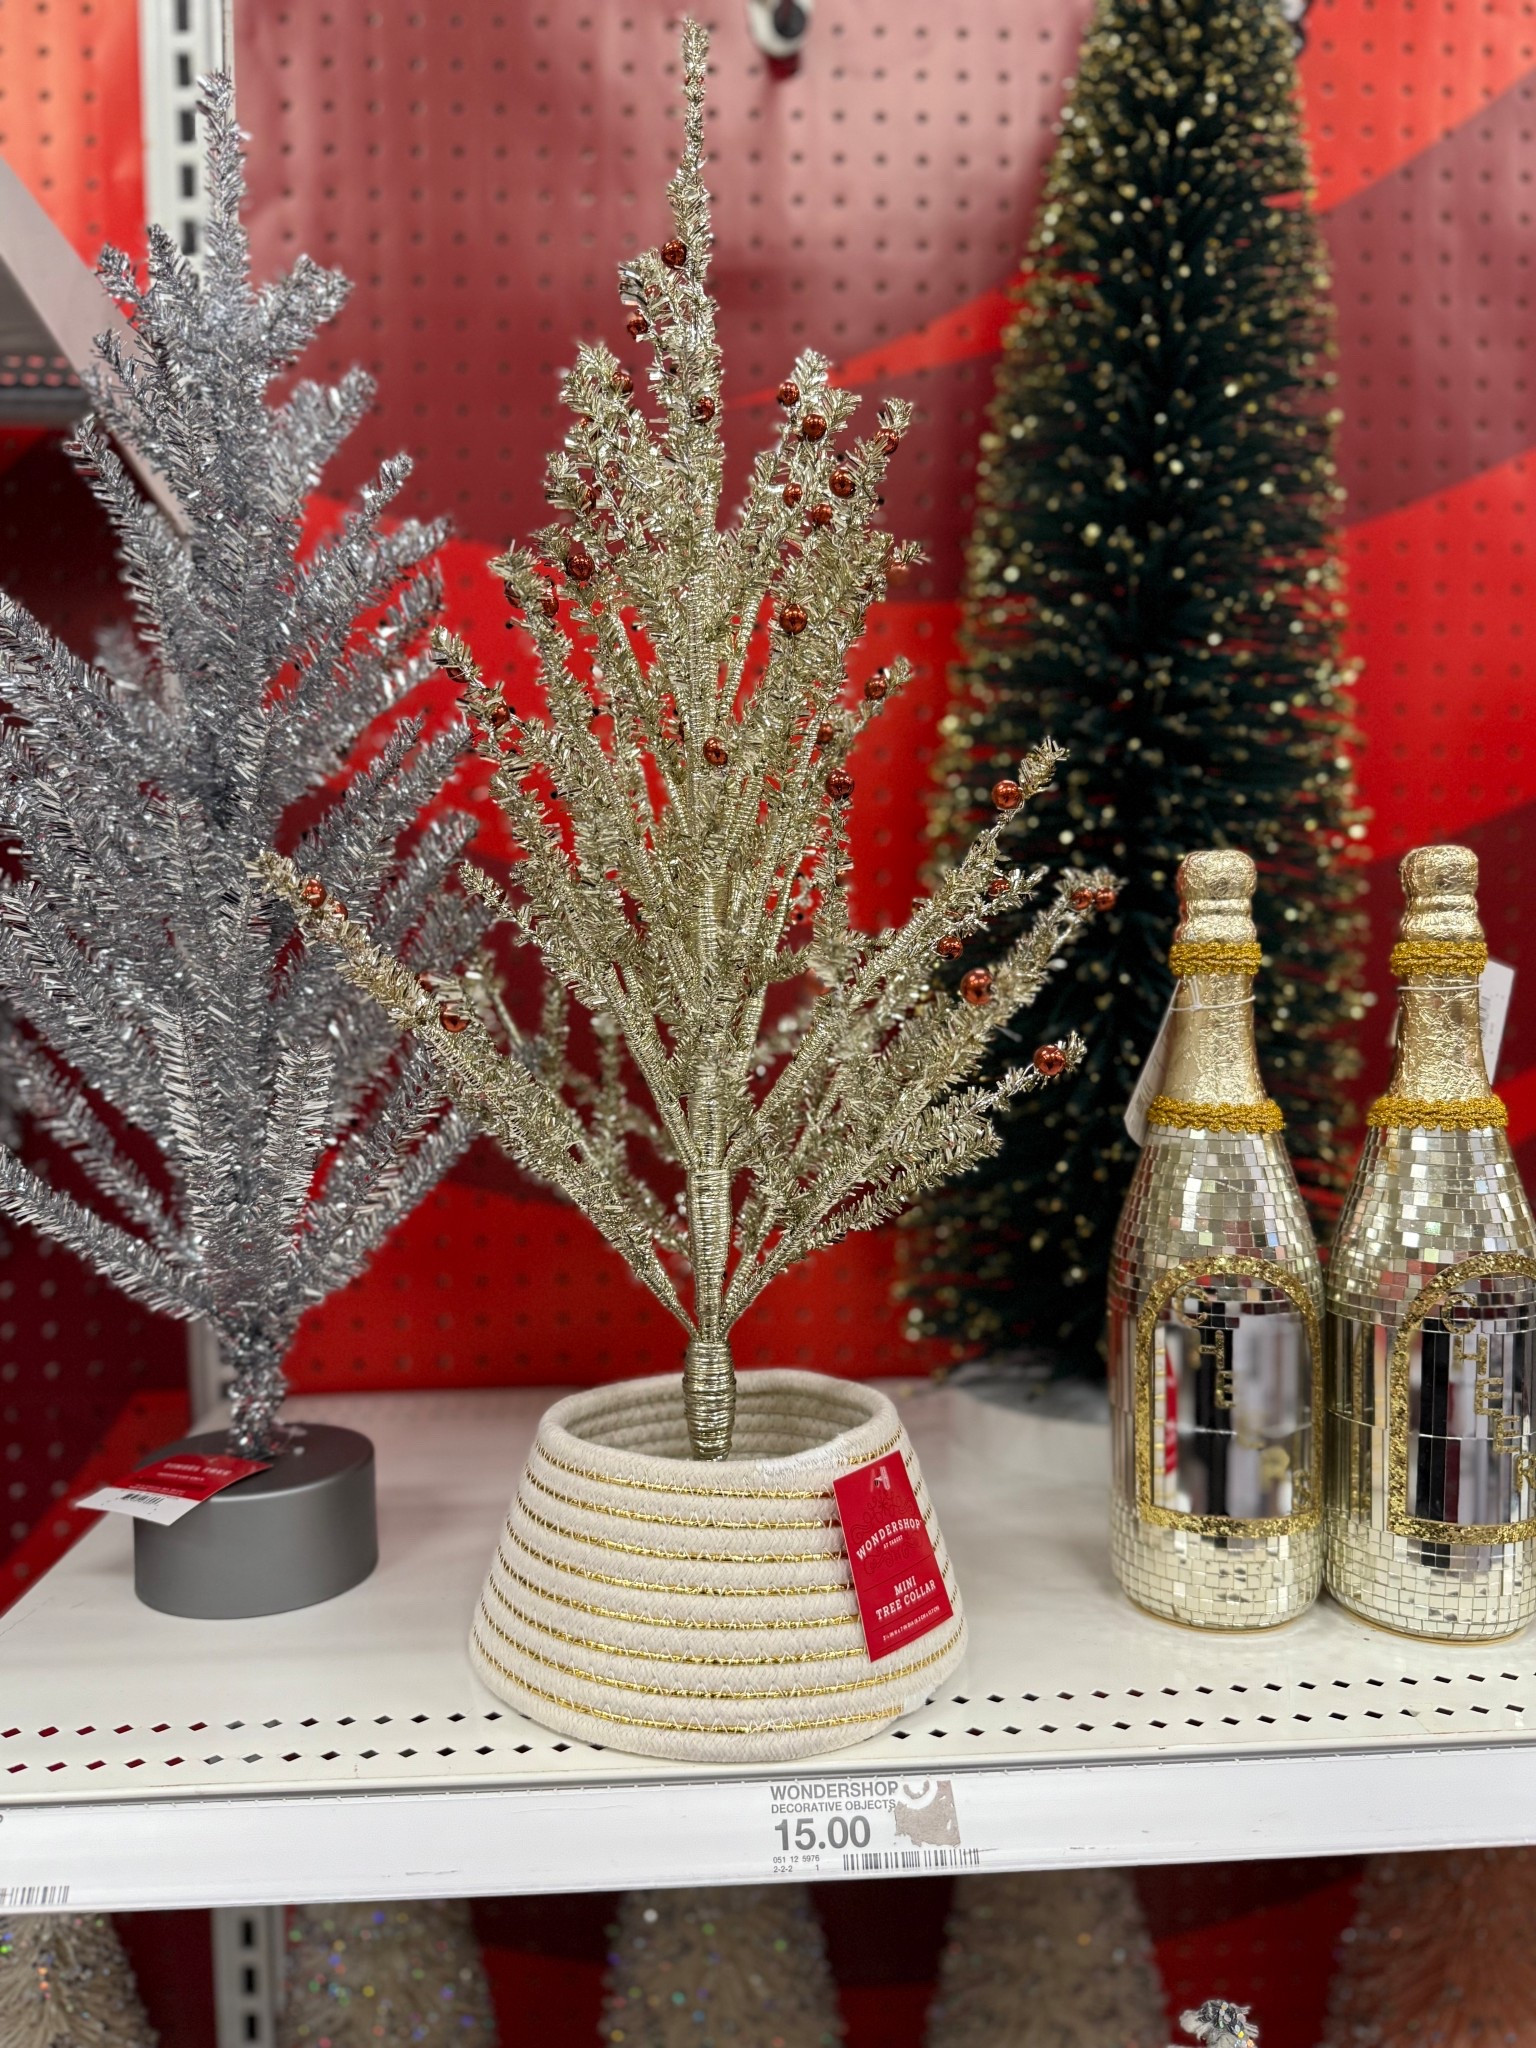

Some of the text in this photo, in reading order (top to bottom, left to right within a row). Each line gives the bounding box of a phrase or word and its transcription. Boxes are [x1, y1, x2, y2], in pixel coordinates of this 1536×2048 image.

[856, 1518, 920, 1561] WONDERSHOP
[894, 1575, 917, 1597] MINI
[875, 1579, 937, 1621] TREE COLLAR
[770, 1780, 899, 1800] WONDERSHOP
[771, 1799, 896, 1814] DECORATIVE OBJECTS
[774, 1815, 871, 1851] 15.00
[772, 1854, 820, 1864] 051 12 5976
[773, 1865, 793, 1873] 2-2-2
